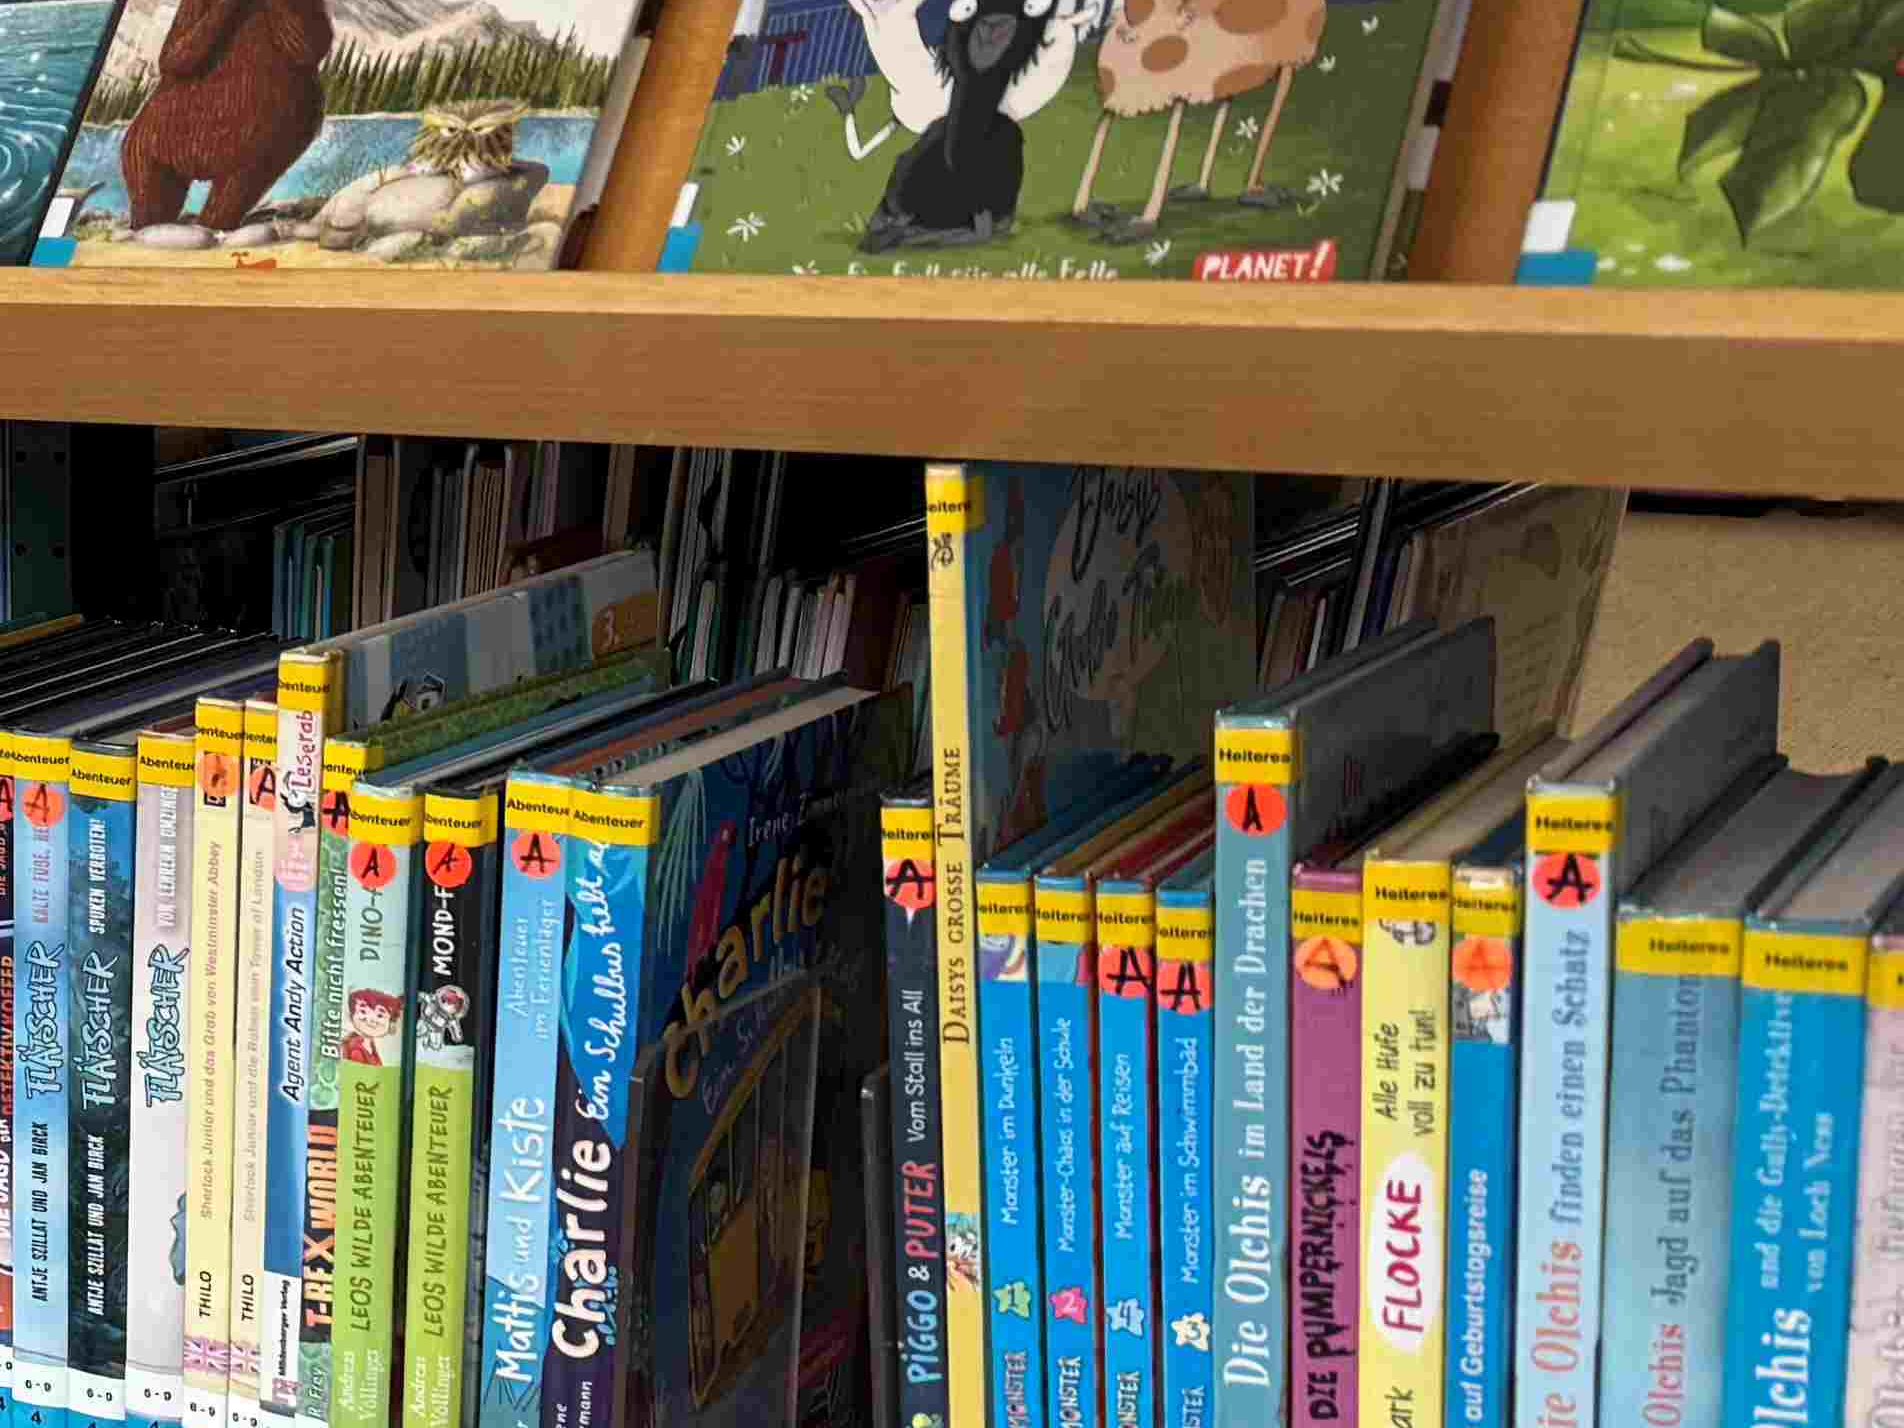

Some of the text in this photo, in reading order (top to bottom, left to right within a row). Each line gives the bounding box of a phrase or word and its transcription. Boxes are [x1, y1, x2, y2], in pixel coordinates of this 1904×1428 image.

[1201, 239, 1333, 282] PLANET!
[570, 808, 647, 834] Abenteuer
[936, 746, 965, 847] TRÄUME
[81, 949, 121, 1111] FLÄTSCHER
[282, 907, 306, 1104] Agent Andy Action
[1223, 858, 1273, 1389] Die Olchis im Land der Drachen
[347, 1079, 381, 1334] LEOS WILDE ABENTEUER
[492, 1092, 548, 1384] Mattis Kiste
[550, 1136, 614, 1361] Charlie
[902, 1160, 939, 1259] PUTER
[1383, 1178, 1425, 1335] FLOCKE
